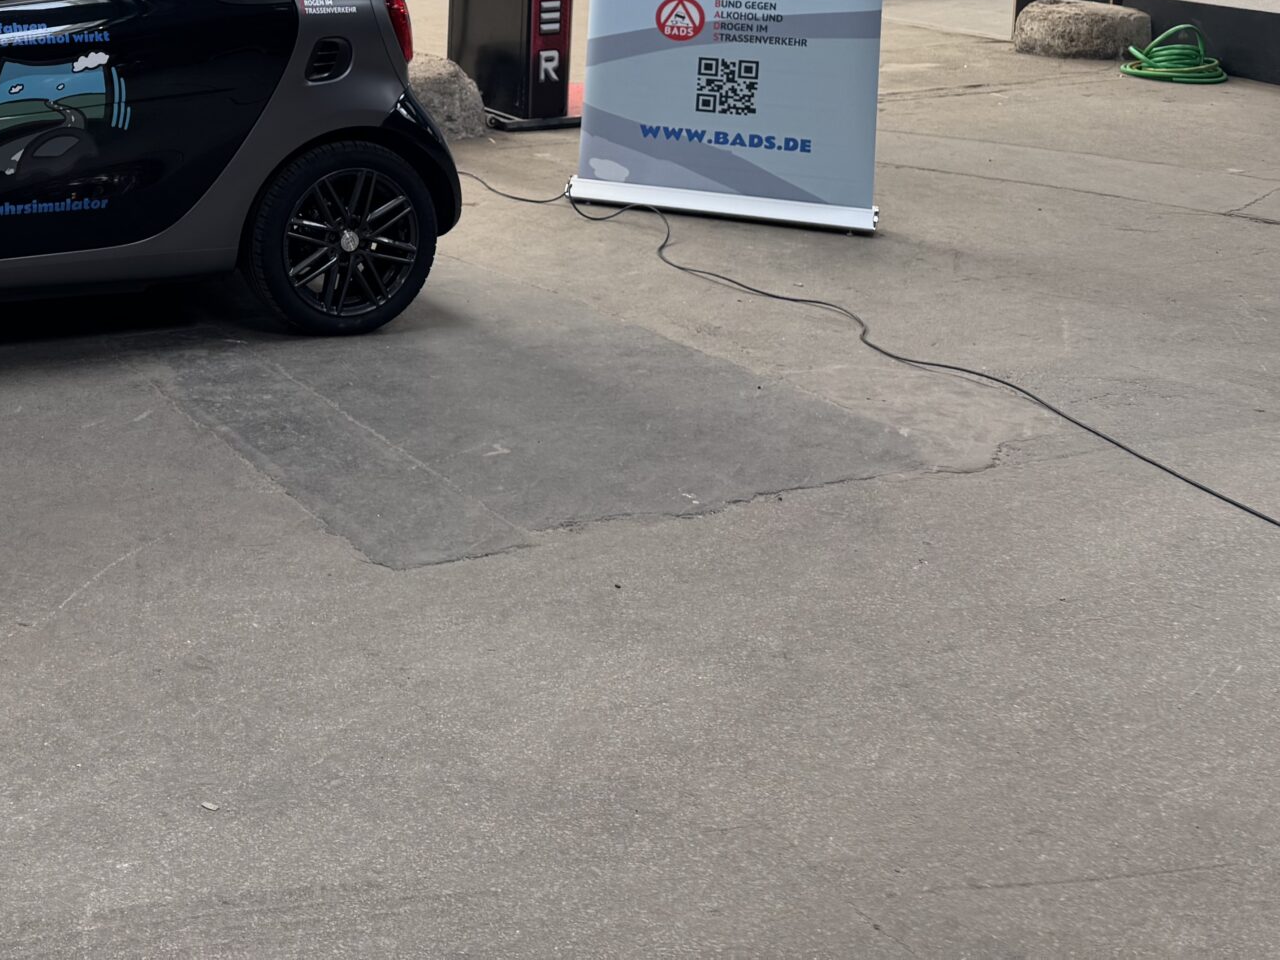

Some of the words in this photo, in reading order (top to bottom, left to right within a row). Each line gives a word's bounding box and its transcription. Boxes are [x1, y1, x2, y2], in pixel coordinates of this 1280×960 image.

[715, 0, 742, 9] BUND
[744, 0, 777, 11] GEGEN
[714, 10, 760, 21] ALKOHOL
[762, 13, 783, 23] UND
[664, 26, 694, 37] BADS
[713, 22, 754, 32] DROGEN
[756, 24, 768, 33] IM
[14, 32, 70, 46] Alkohol
[72, 31, 111, 43] wirkt
[713, 32, 808, 48] STRASSENVERKEHR
[640, 124, 812, 153] WWW.BADS.DE
